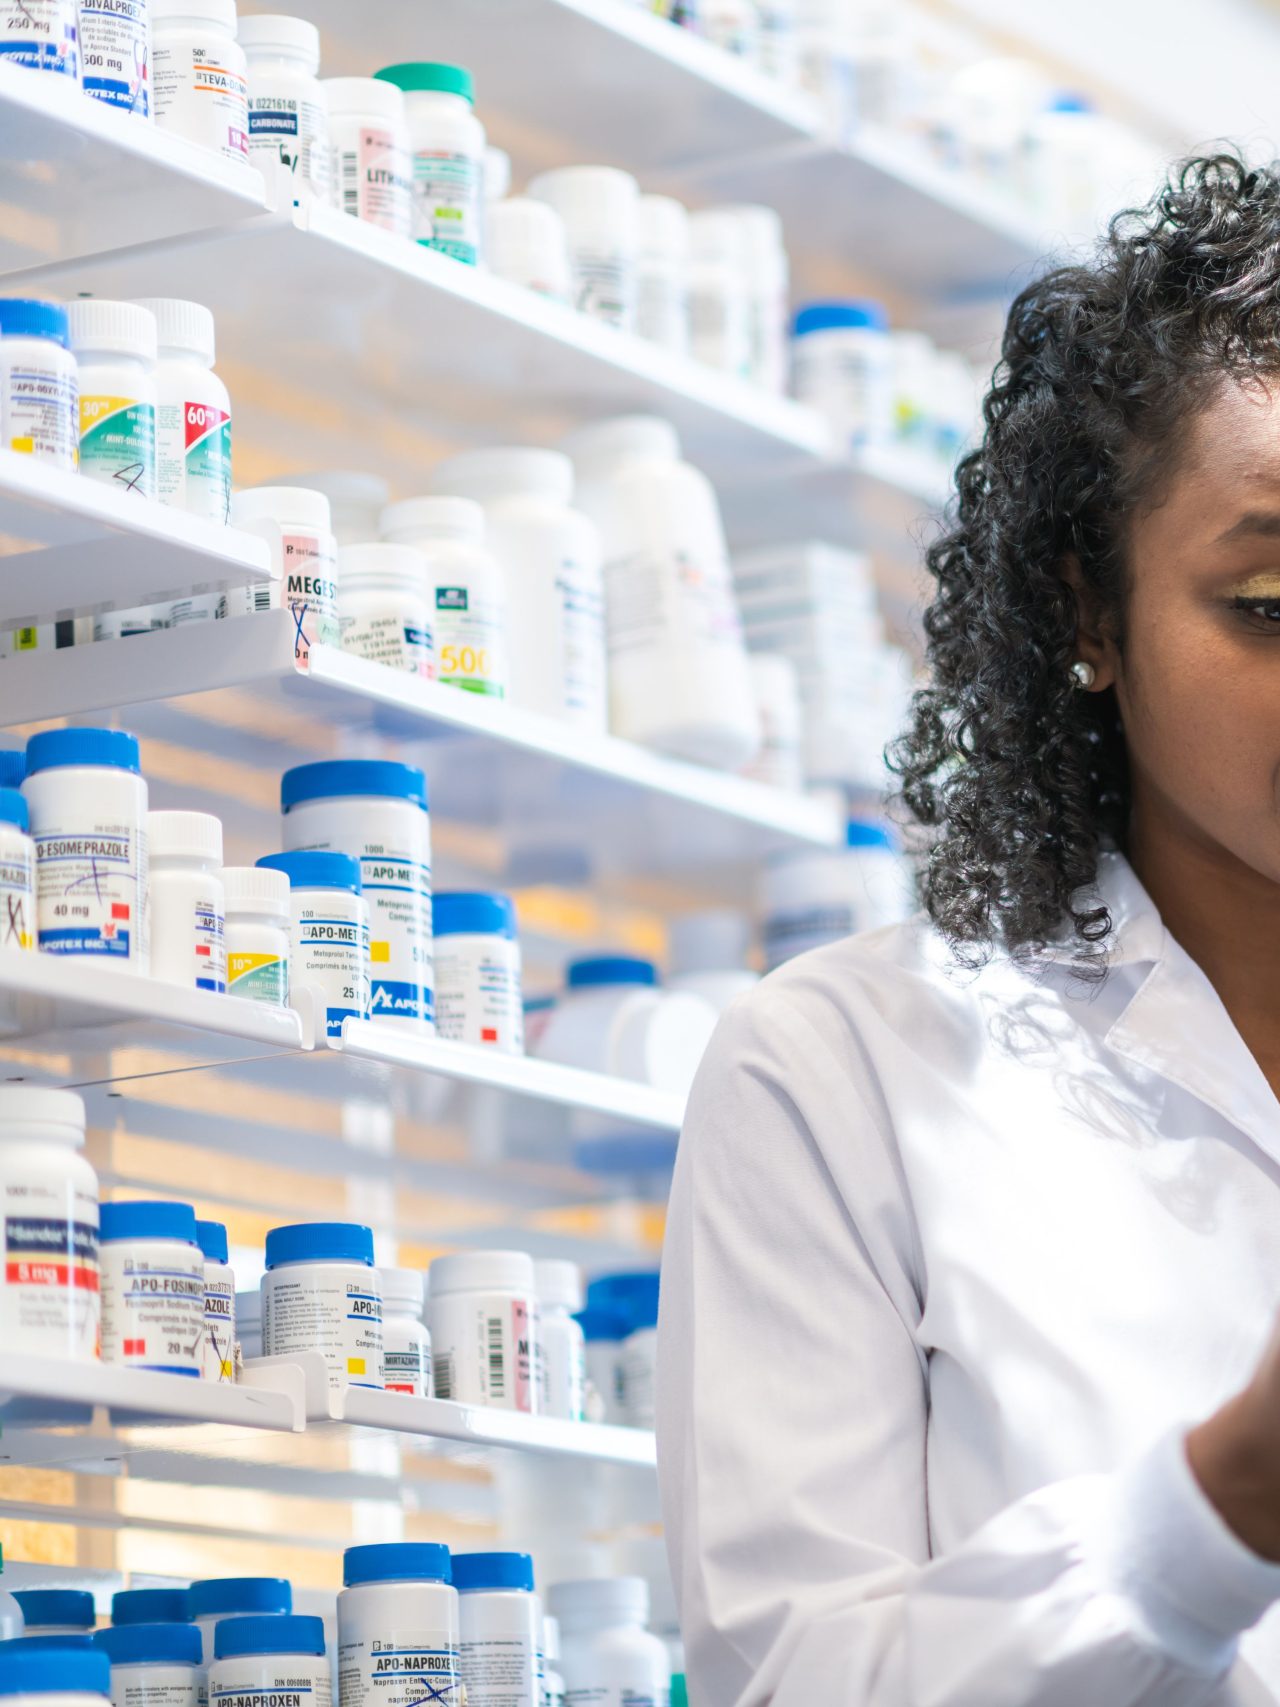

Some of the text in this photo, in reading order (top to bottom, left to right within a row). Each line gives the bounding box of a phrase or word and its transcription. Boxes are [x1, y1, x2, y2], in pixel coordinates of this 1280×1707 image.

[8, 18, 50, 33] 250 mg
[192, 48, 206, 57] 500
[84, 54, 122, 71] 500 mg
[256, 98, 297, 111] 02216140
[251, 117, 296, 130] CARBONATE
[83, 401, 98, 416] 30
[187, 406, 205, 426] 60
[365, 844, 384, 854] 1000
[54, 904, 89, 918] 40 mg
[302, 910, 314, 918] 100
[232, 958, 244, 970] 10
[306, 962, 340, 971] Comprimés
[343, 986, 354, 999] 25
[32, 1266, 58, 1286] mg
[204, 1298, 230, 1314] AZOLE
[168, 1342, 180, 1354] 20
[383, 1643, 394, 1651] 100
[274, 1679, 285, 1687] DIN
[373, 1678, 407, 1687] Naproxen
[217, 1694, 300, 1707] APO-NAPROXEN
